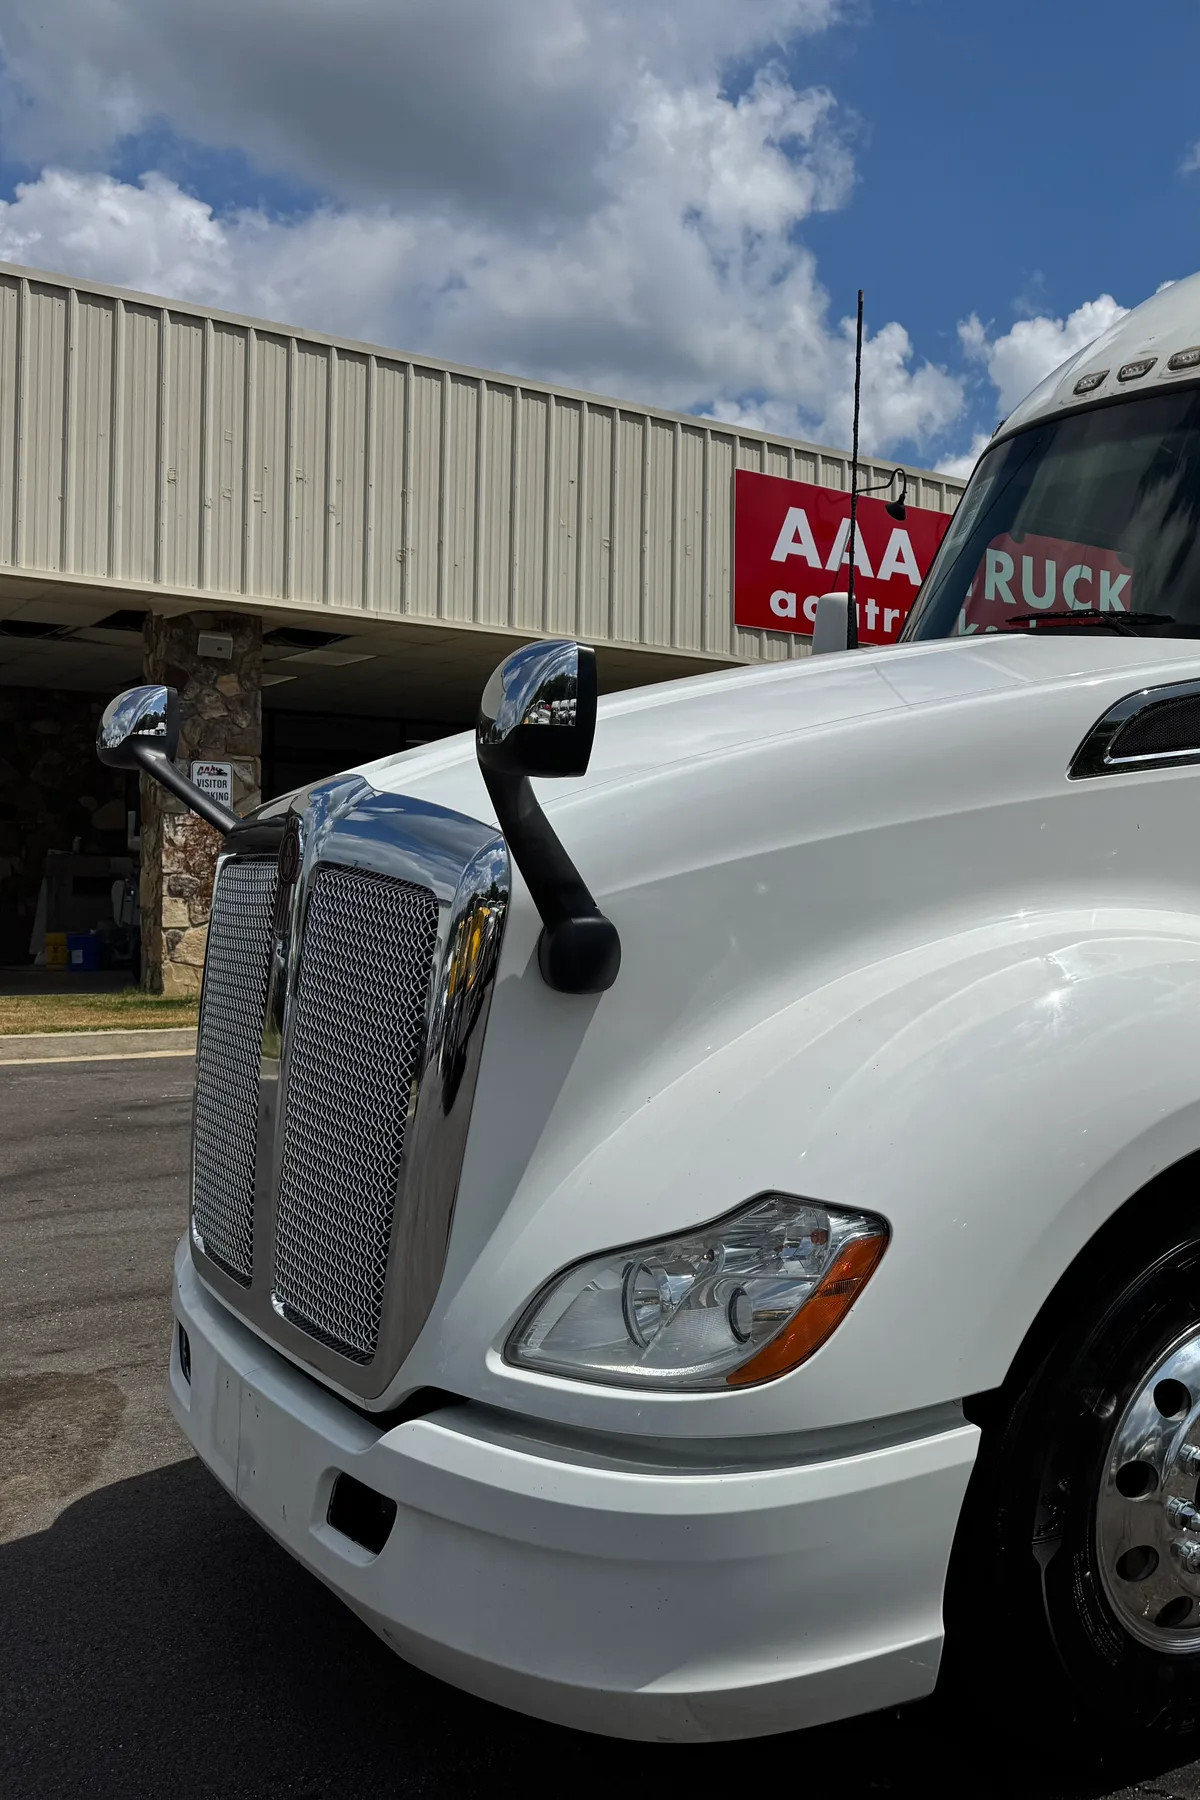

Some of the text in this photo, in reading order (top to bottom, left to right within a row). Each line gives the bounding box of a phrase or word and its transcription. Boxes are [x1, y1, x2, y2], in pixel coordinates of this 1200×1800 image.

[770, 506, 922, 587] AAA
[965, 548, 1132, 612] RUCK
[196, 779, 228, 788] VISITOR
